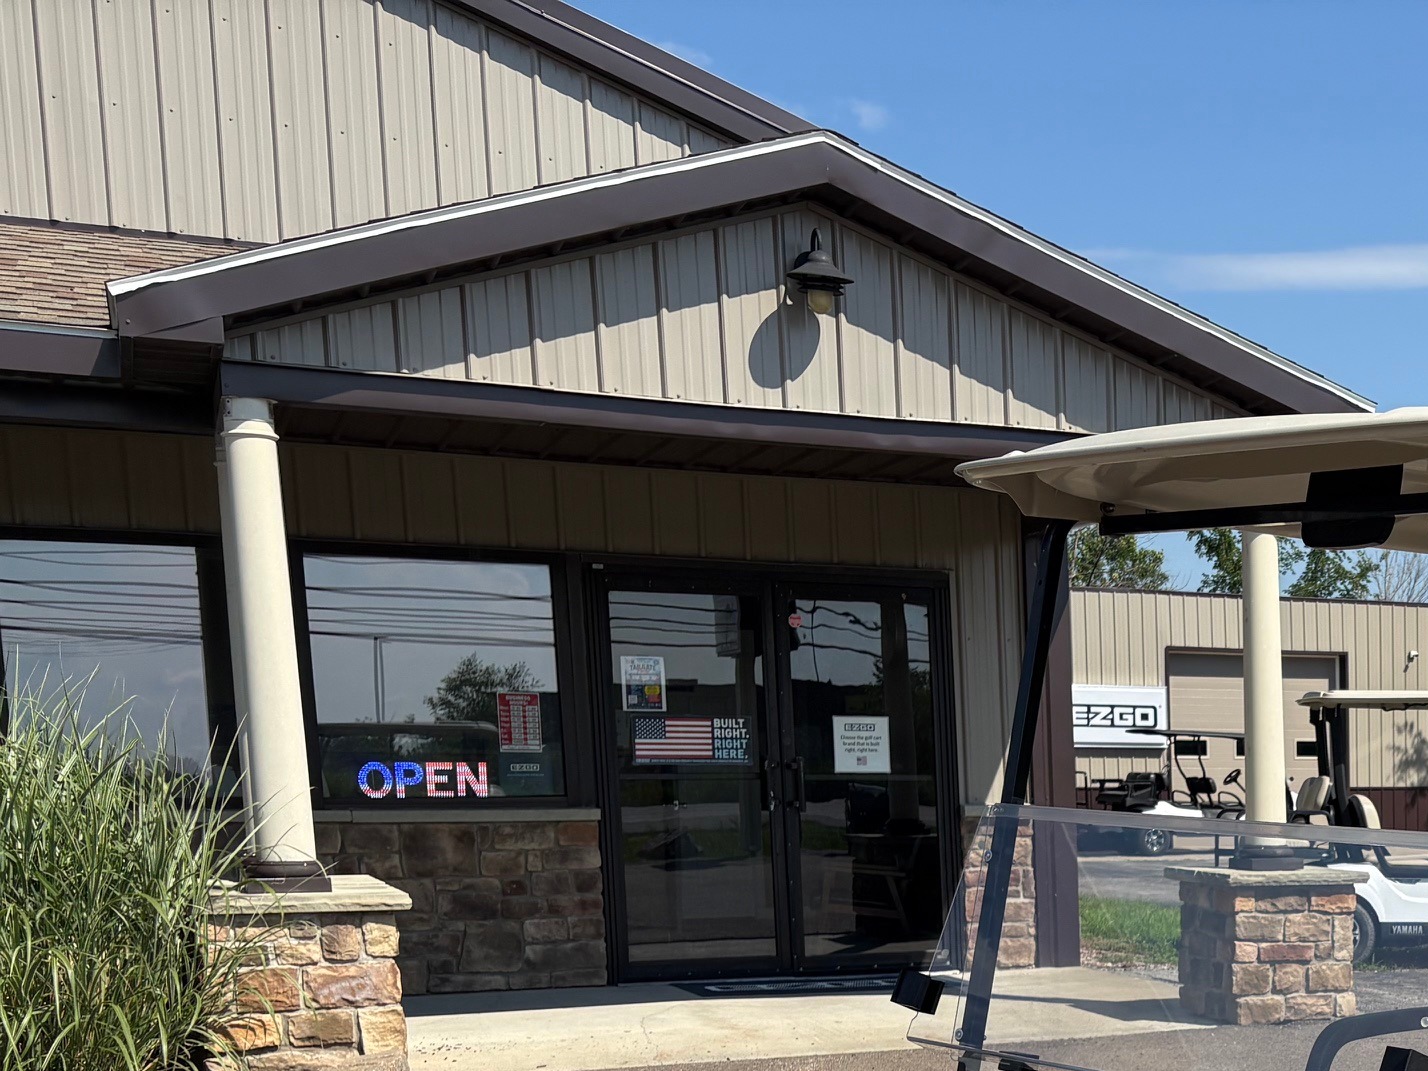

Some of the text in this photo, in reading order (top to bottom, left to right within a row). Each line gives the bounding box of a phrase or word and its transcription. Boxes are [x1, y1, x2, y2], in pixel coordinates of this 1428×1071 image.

[713, 718, 745, 728] BUILT
[713, 728, 750, 738] RIGHT.
[714, 738, 748, 749] RIGHT
[357, 761, 488, 799] OPEN
[1392, 925, 1424, 935] YAMAHA
